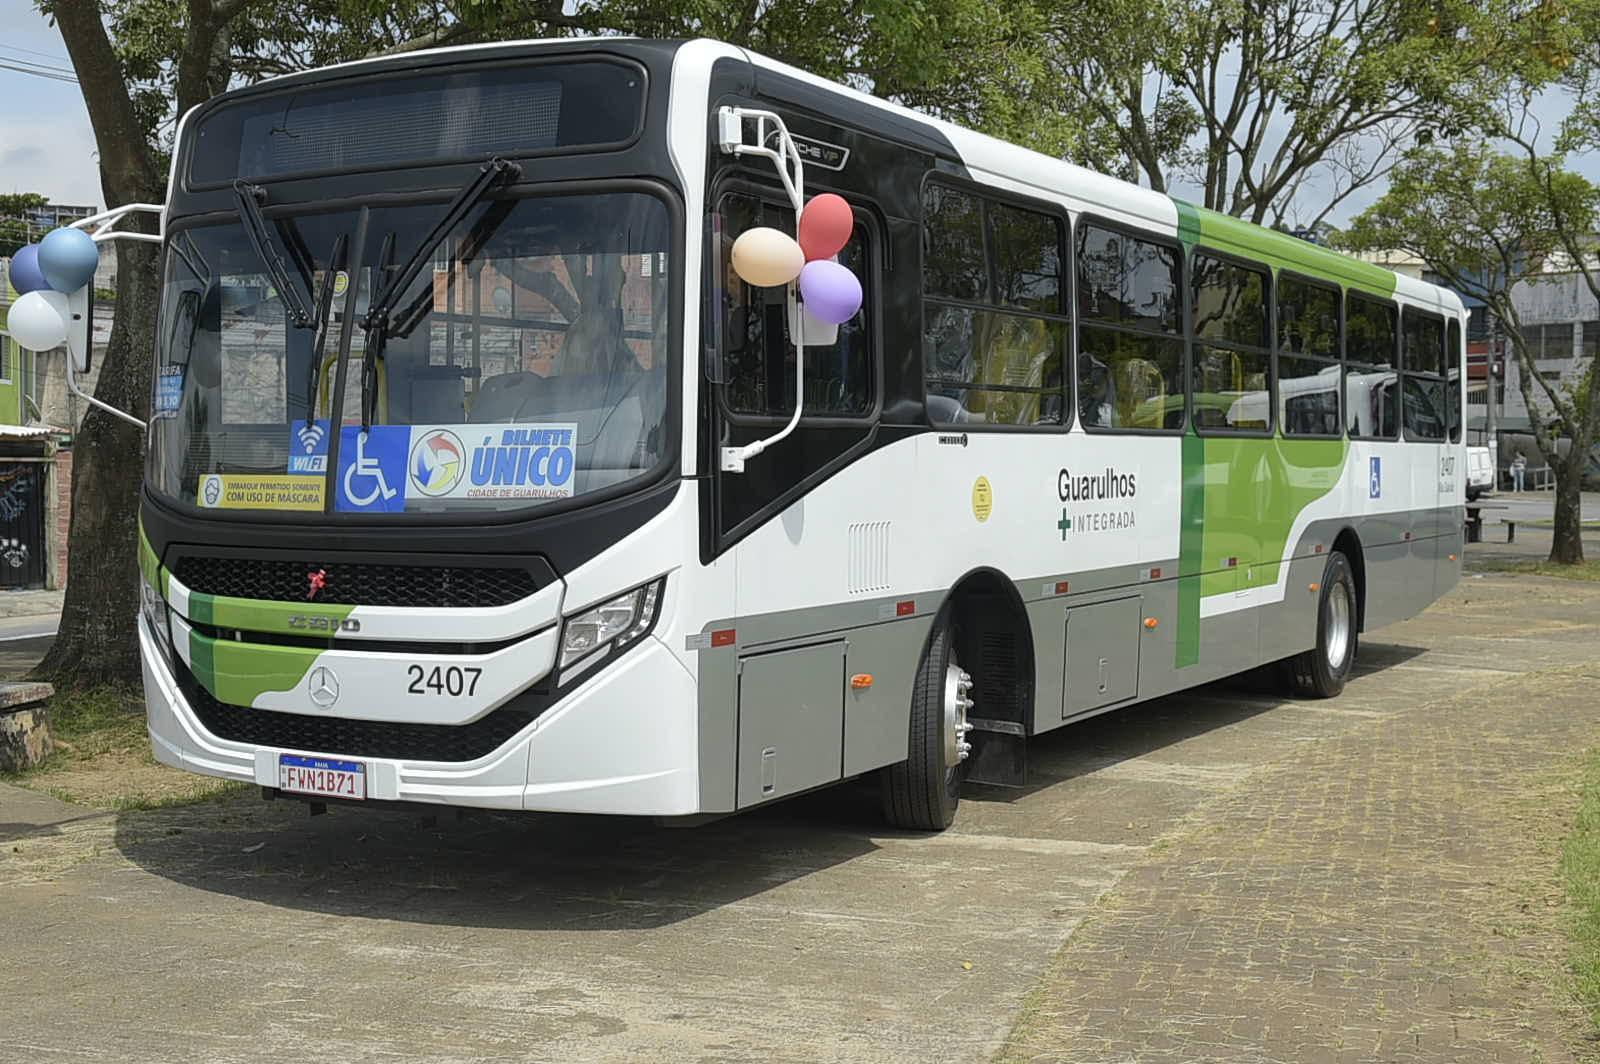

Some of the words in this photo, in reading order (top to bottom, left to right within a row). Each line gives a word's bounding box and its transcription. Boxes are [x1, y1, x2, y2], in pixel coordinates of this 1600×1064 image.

[501, 429, 573, 446] BILHETE
[470, 436, 574, 486] ÚNICO
[260, 483, 291, 491] PERMITIDO
[467, 488, 497, 498] CIDADE
[499, 488, 511, 498] DE
[515, 488, 568, 498] GUARULHOS
[1058, 467, 1136, 502] Guarulhos
[226, 491, 245, 502] COM
[246, 491, 263, 502] USO
[265, 492, 276, 503] DE
[1072, 511, 1136, 533] INTEGRADA
[407, 664, 483, 697] 2407
[287, 767, 355, 795] FWN1B71
